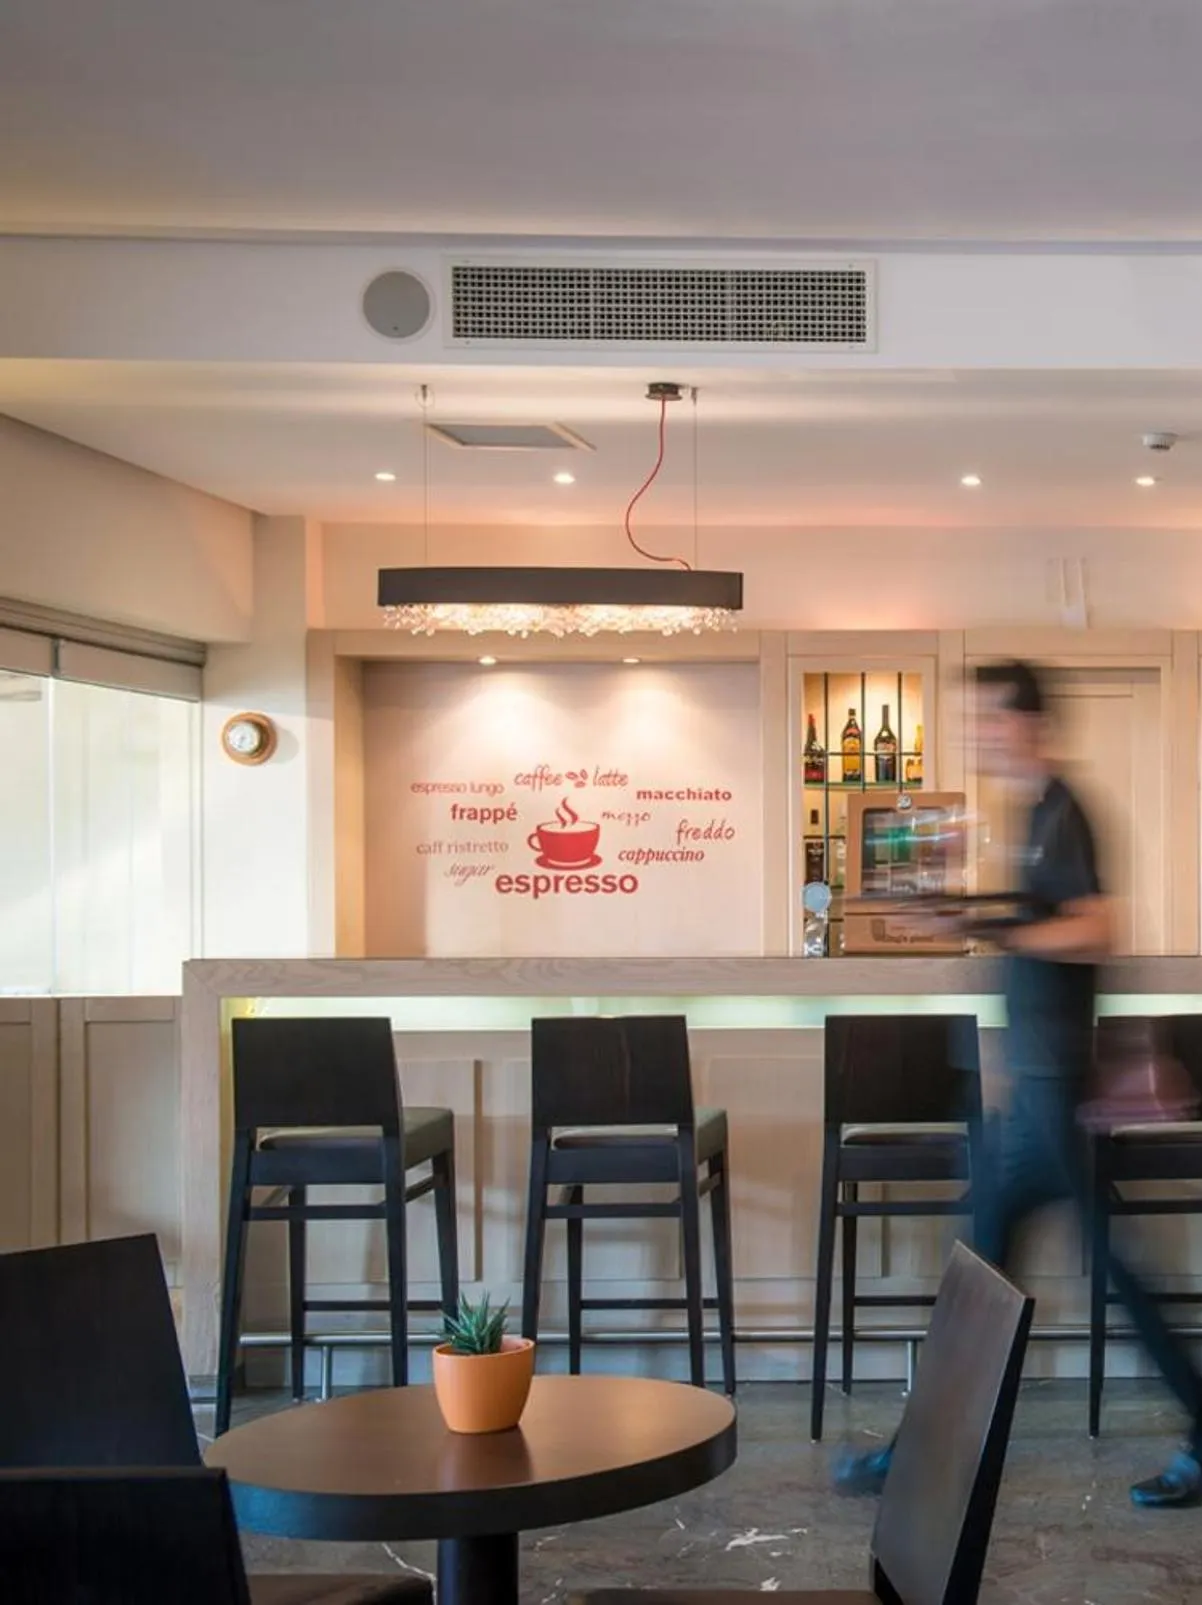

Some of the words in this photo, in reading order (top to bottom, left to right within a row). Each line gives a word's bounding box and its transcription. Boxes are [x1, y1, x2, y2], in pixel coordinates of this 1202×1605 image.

[513, 764, 563, 791] caffee
[592, 764, 629, 787] latte
[410, 782, 467, 795] espresso
[469, 781, 504, 797] lungo
[636, 788, 732, 801] macchiato
[450, 801, 518, 825] frappé
[601, 811, 651, 827] mezzo
[675, 818, 736, 846] freddo
[447, 841, 510, 854] ristretto
[617, 846, 705, 866] cappuccino
[494, 873, 639, 899] espresso
